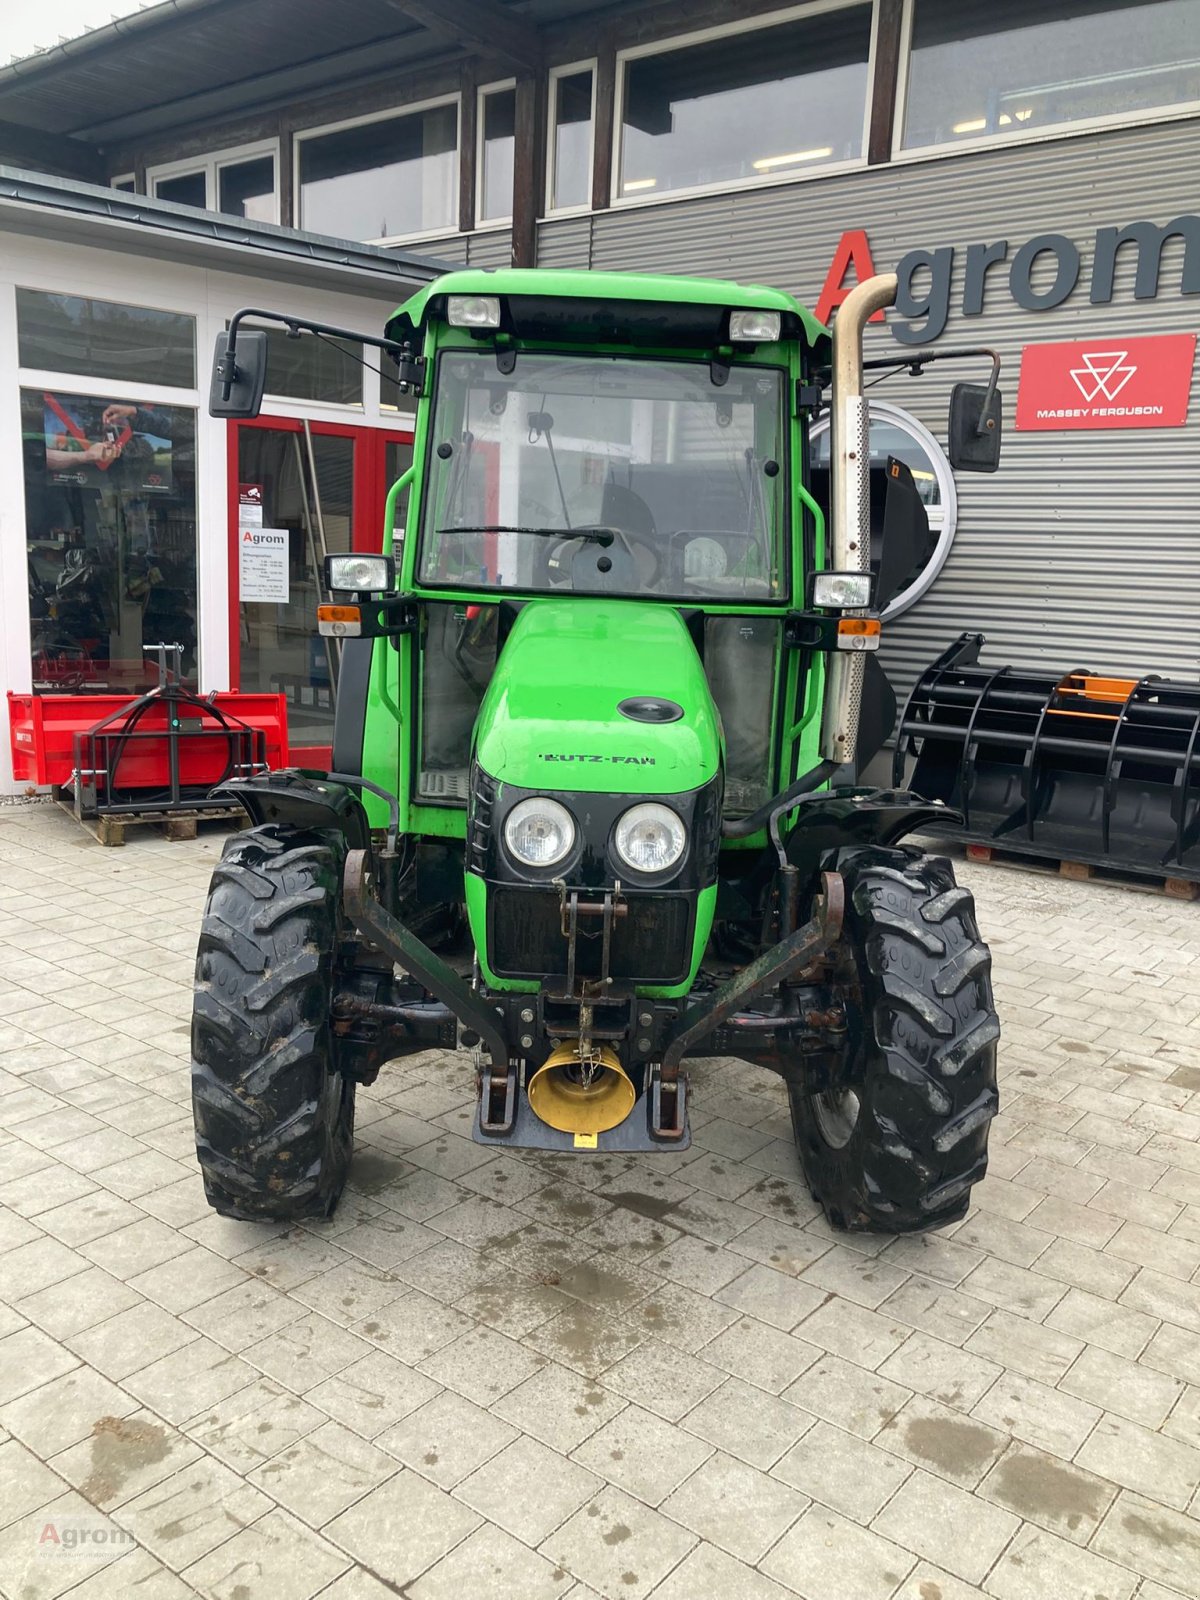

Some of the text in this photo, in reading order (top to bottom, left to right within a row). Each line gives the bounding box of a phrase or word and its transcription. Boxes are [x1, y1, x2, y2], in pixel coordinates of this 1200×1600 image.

[815, 216, 1200, 344] Agrom
[1037, 406, 1163, 418] MASSEY FERGUSON
[243, 532, 285, 544] Agrom
